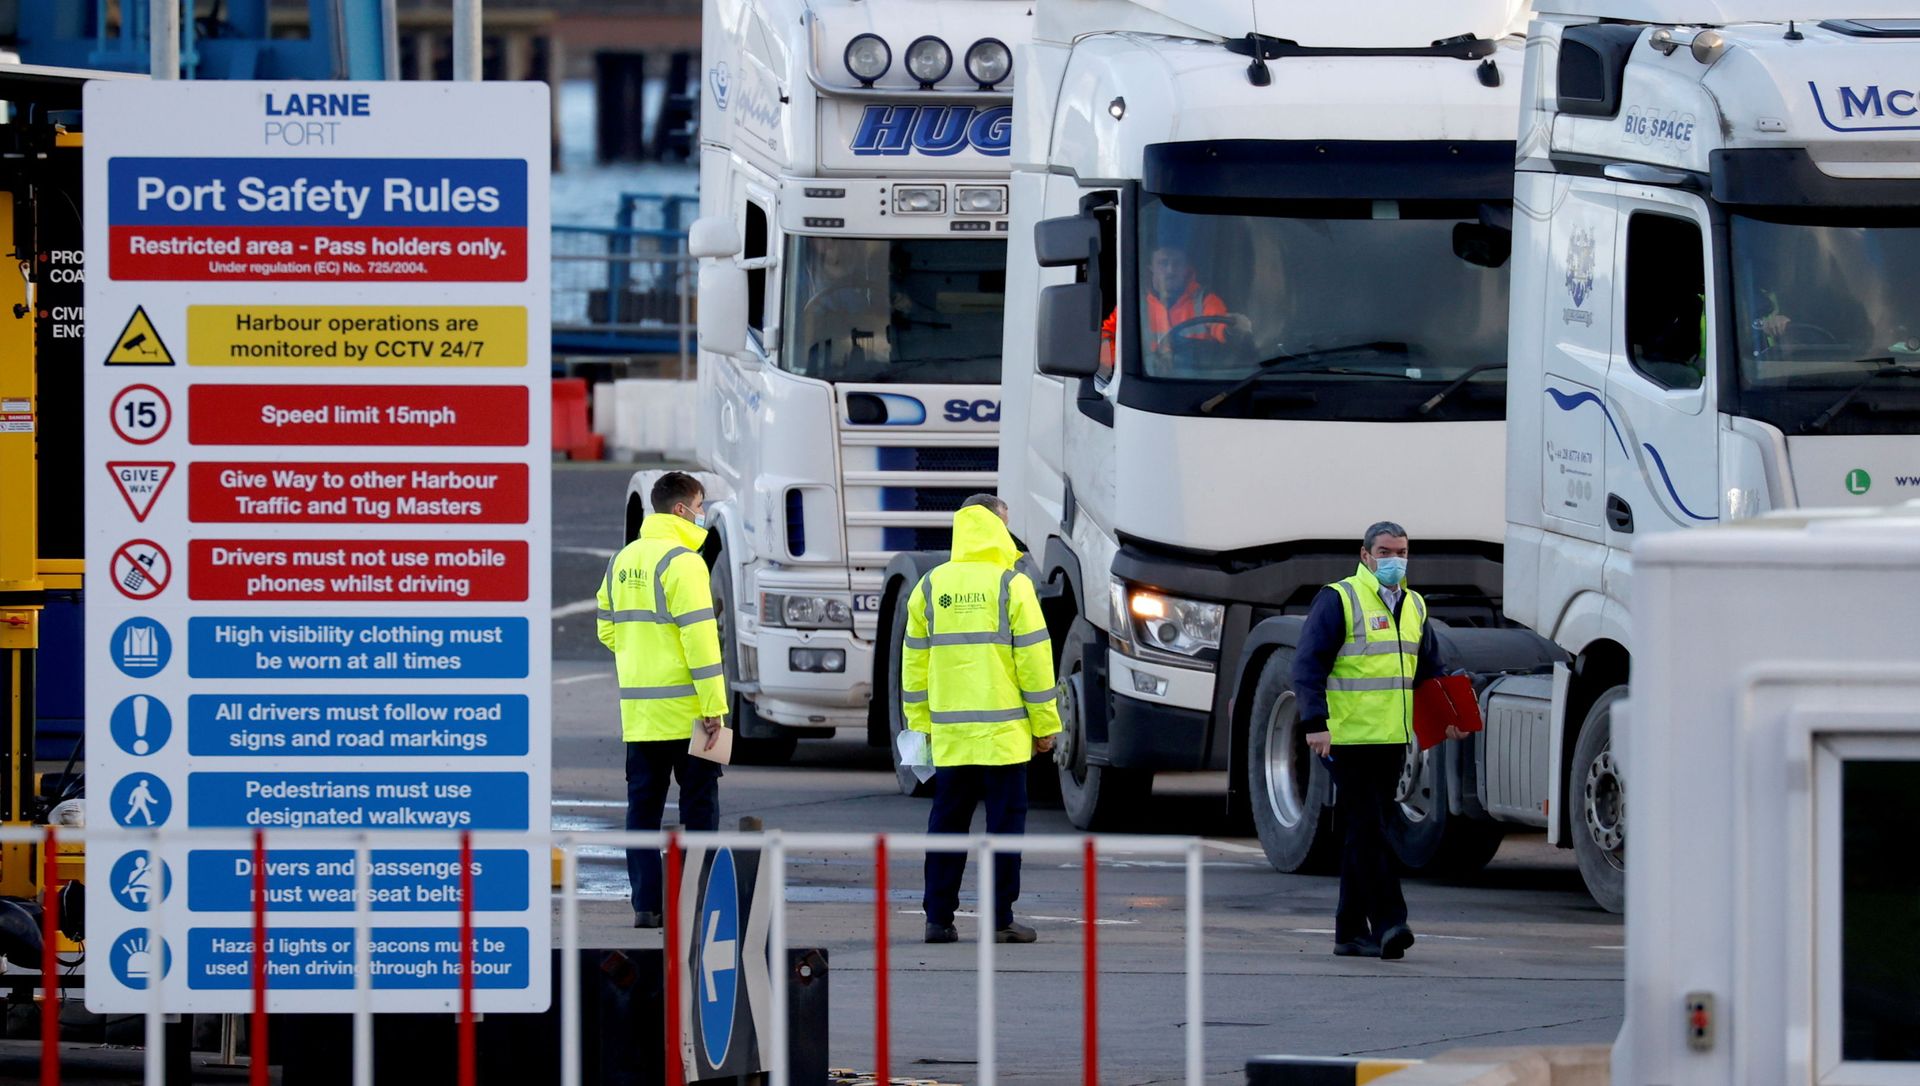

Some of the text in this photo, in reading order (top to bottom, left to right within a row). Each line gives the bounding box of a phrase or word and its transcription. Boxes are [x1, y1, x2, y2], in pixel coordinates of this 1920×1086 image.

[266, 94, 370, 116] LARNE
[265, 122, 341, 146] PORT
[851, 104, 1013, 156] HUG
[1625, 115, 1694, 142] BIG SPACE
[138, 177, 499, 219] Port Safety Rules
[51, 250, 84, 264] PRO
[131, 236, 240, 254] Restricted
[246, 241, 293, 255] area
[315, 237, 366, 255] Pass
[372, 237, 452, 255] holders
[457, 238, 506, 259] only.
[50, 269, 85, 283] COA
[209, 261, 427, 275] Under regulation (EC) No. 725/2004.
[52, 306, 85, 321] CIVI
[237, 314, 478, 334] Harbour operations are
[231, 341, 484, 361] monitored by CCTV 24/7
[125, 402, 157, 428] 15
[262, 405, 455, 427] Speed limit 15mph
[121, 469, 159, 482] GIVE
[220, 470, 498, 491] Give Way to other Harbour
[129, 485, 154, 494] WAY
[236, 496, 481, 518] Traffic and Tug Masters
[212, 548, 505, 566] Drivers must not use mobile
[248, 574, 469, 596] phones whilst driving
[216, 626, 502, 647] High visibility clothing must
[256, 652, 461, 669] be worn at all times
[216, 703, 501, 720] All drivers must follow road
[230, 730, 487, 750] signs and road markings
[246, 781, 471, 798] Pedestrians must use
[246, 807, 470, 828] designated walkways
[316, 859, 356, 876] and
[364, 861, 483, 880] assenges
[308, 888, 361, 902] wear
[367, 886, 411, 902] seat
[212, 938, 506, 956] Hazad lights or eacons mut be
[205, 961, 249, 976] used
[256, 961, 300, 976] hen
[368, 960, 438, 978] through
[442, 960, 512, 975] habour
